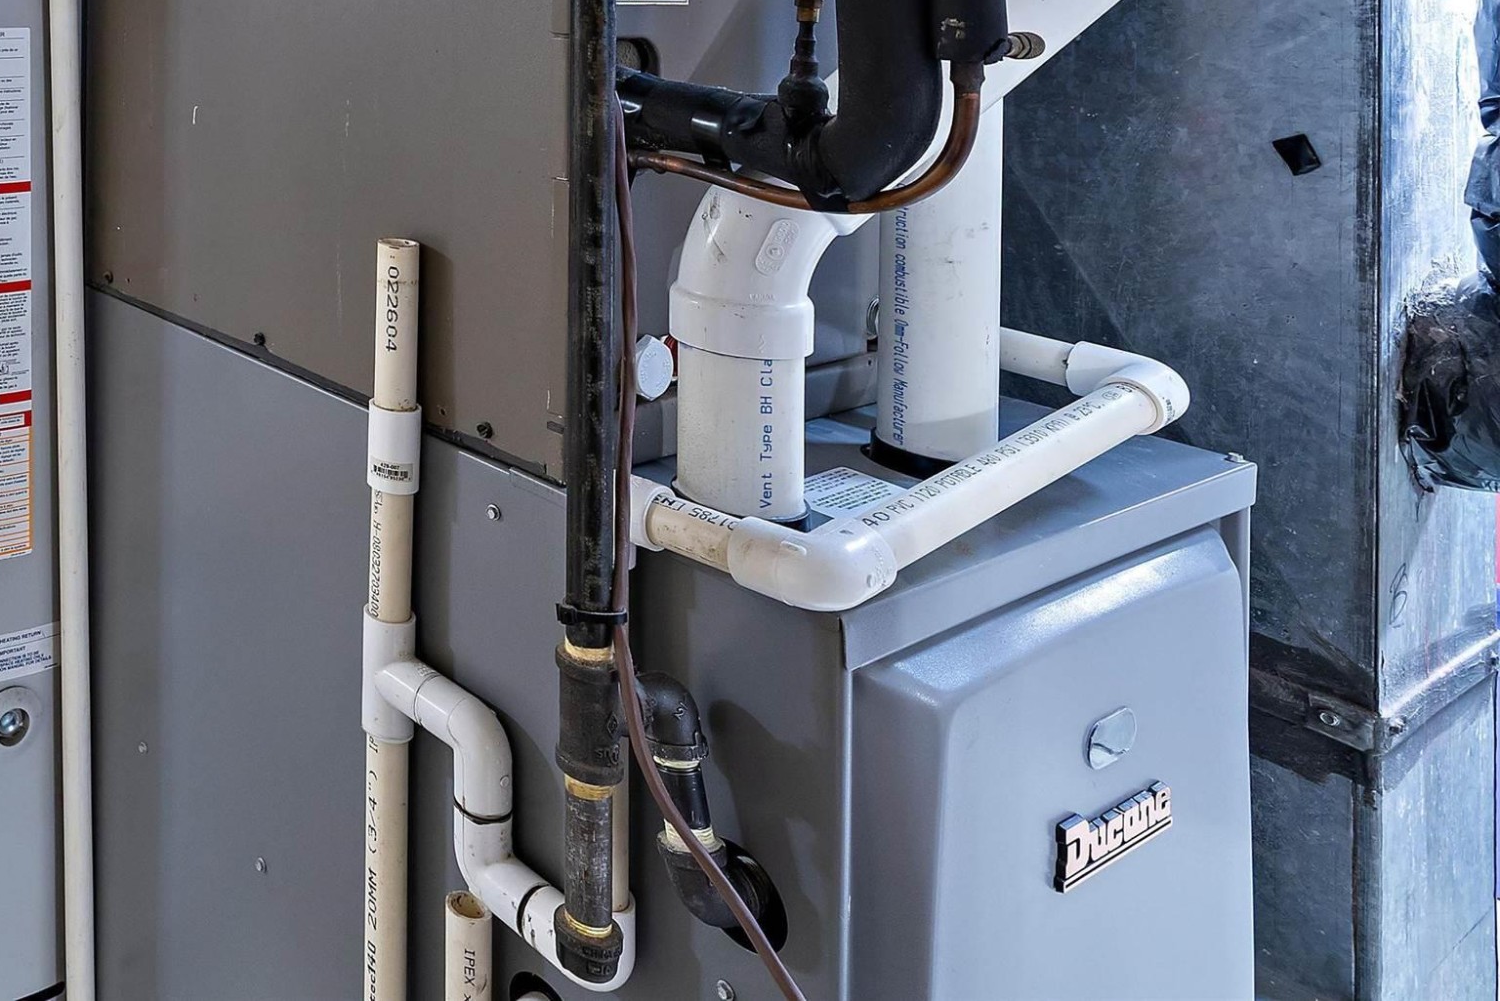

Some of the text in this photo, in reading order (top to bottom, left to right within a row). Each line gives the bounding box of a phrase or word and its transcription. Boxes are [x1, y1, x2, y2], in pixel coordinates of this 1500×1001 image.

[385, 265, 400, 352] 022604
[893, 254, 911, 316] combustible
[760, 396, 773, 415] BH
[892, 376, 909, 446] Manufacturer
[760, 424, 773, 462] Type
[760, 473, 773, 509] Vent
[861, 510, 890, 528] 40
[887, 498, 915, 515] PVC
[934, 463, 983, 491] POTABLE
[0, 635, 21, 644] HEATING
[21, 630, 41, 639] RETURN
[1062, 780, 1173, 879] Ducane
[367, 866, 378, 932] 20MM
[464, 947, 476, 987] IPEX
